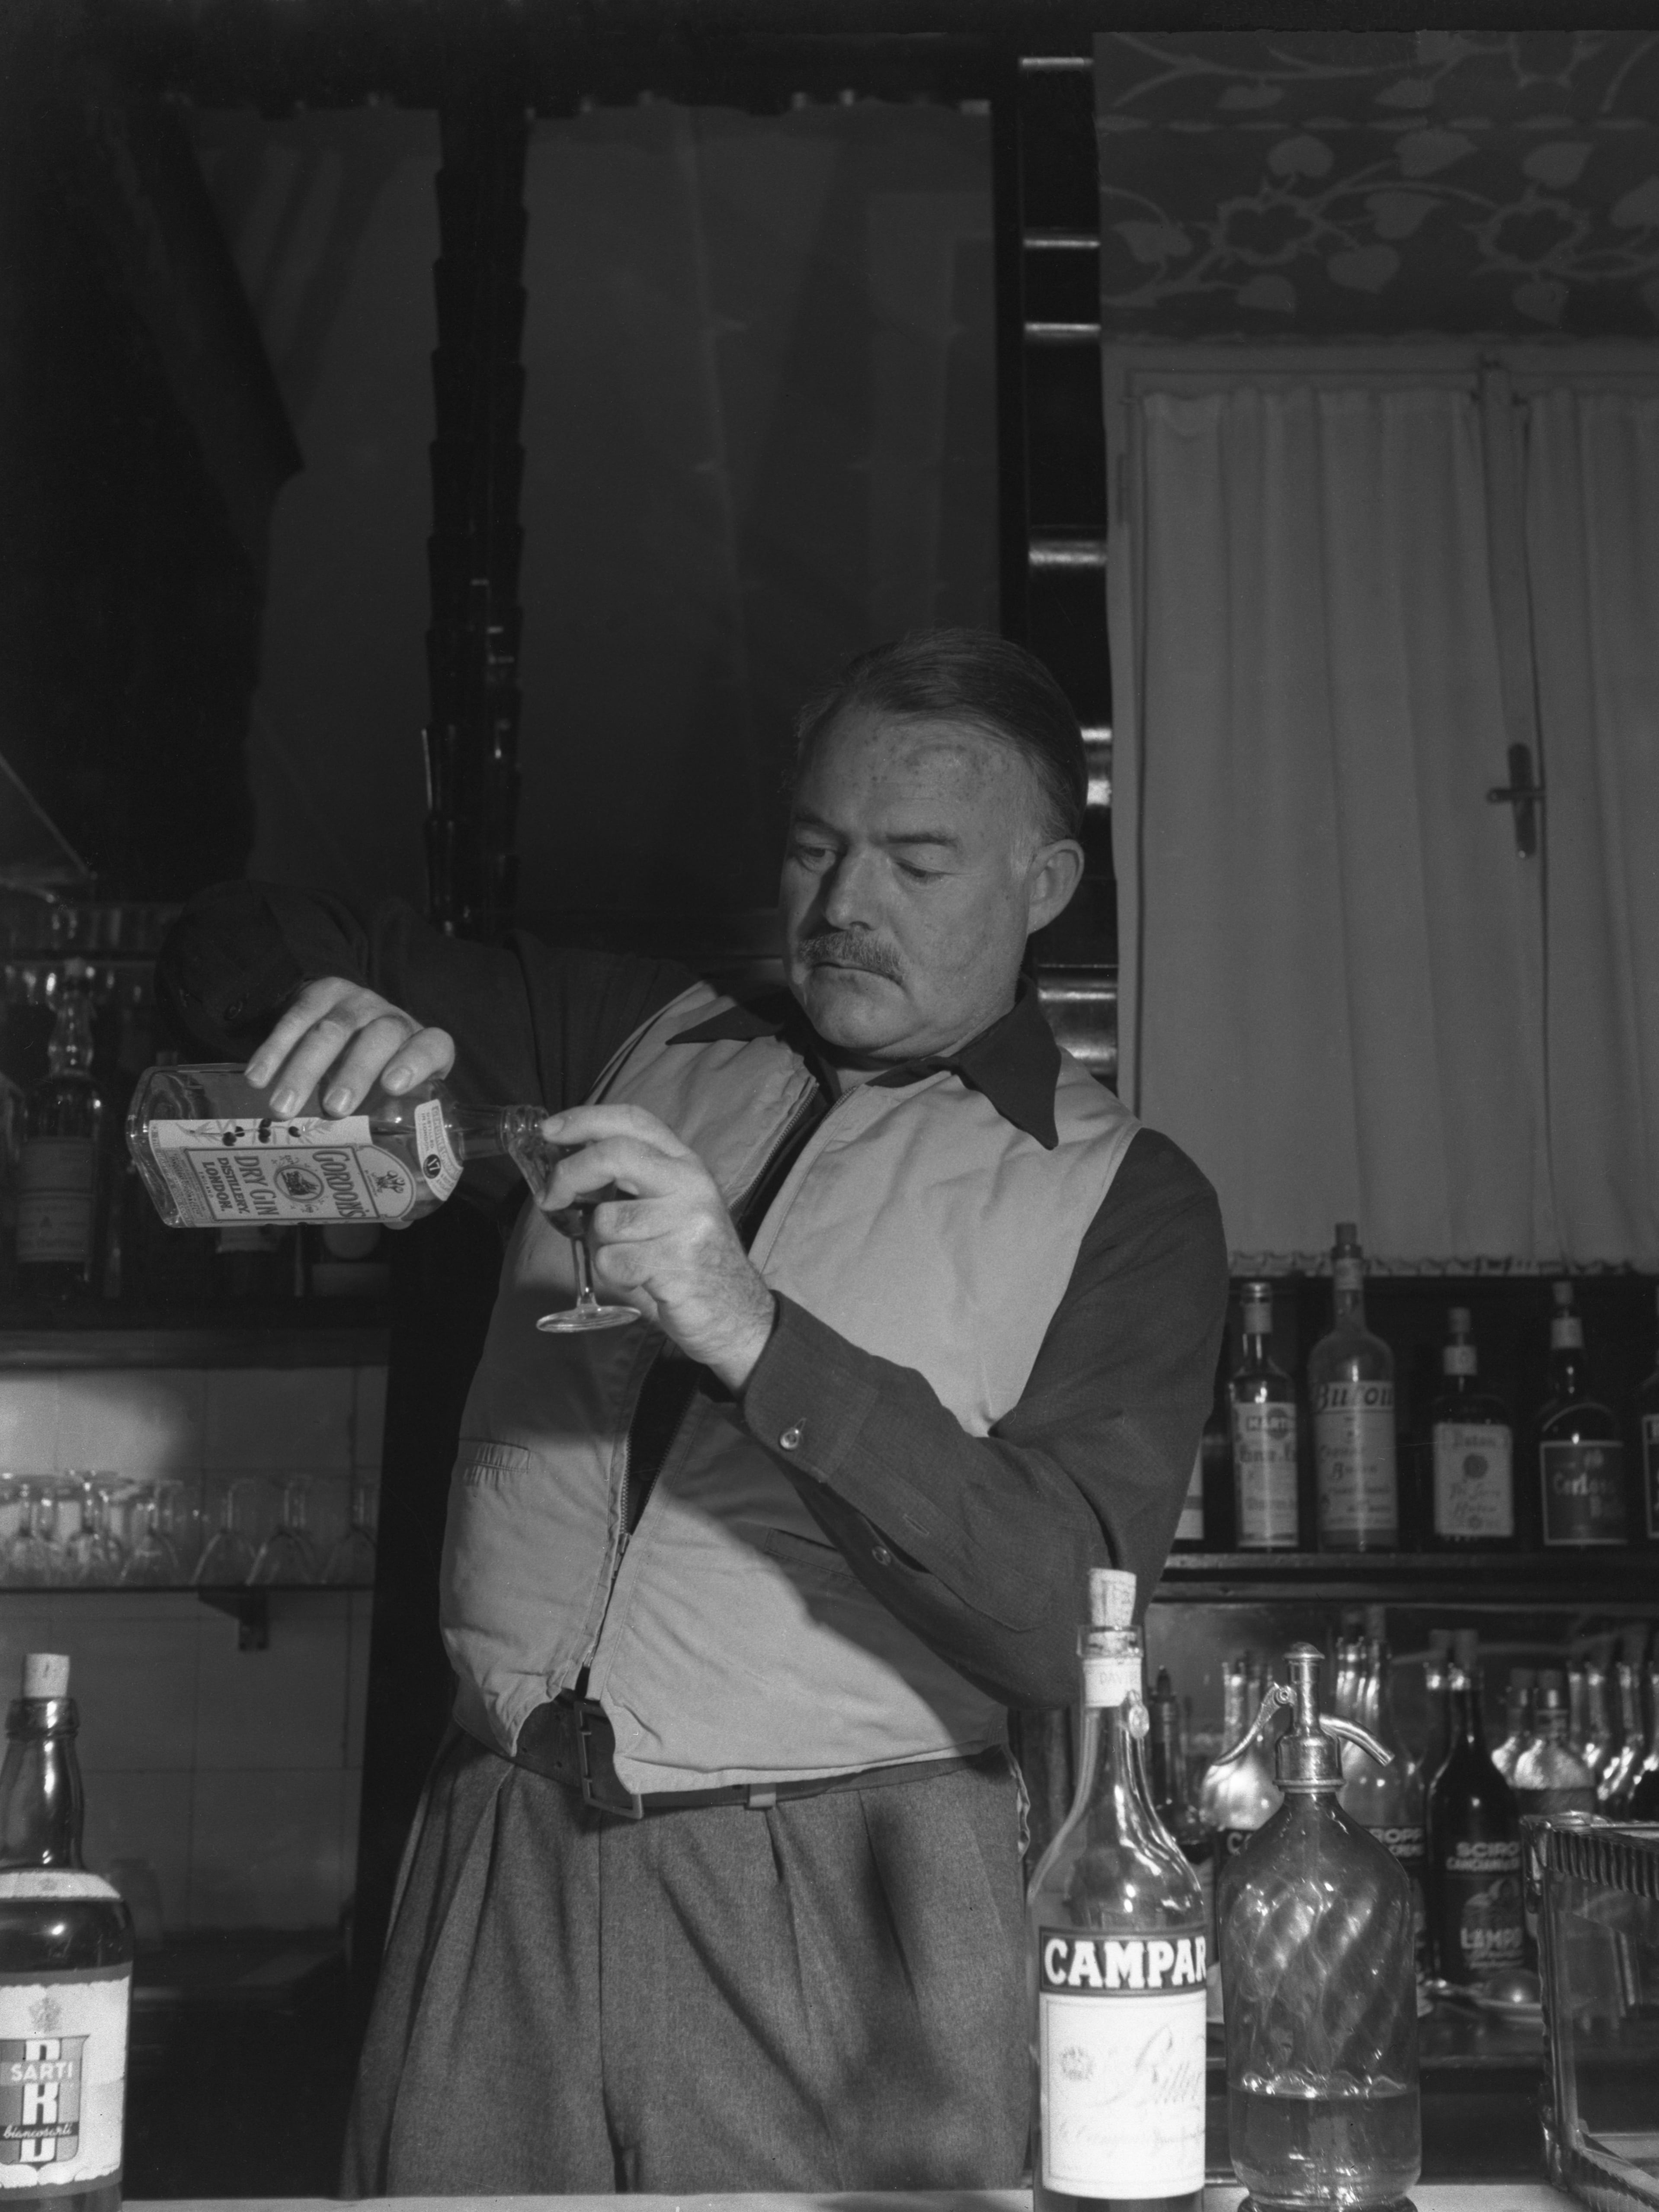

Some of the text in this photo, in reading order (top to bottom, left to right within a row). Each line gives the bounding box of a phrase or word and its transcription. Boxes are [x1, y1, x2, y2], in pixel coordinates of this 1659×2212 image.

[199, 1171, 214, 1198] ENGLAND
[202, 1161, 233, 1212] LONDON.
[217, 1157, 250, 1214] DISTILLERY.
[234, 1155, 280, 1215] DRY GIN
[312, 1150, 370, 1217] GORDON'S
[10, 2061, 74, 2082] SARTI
